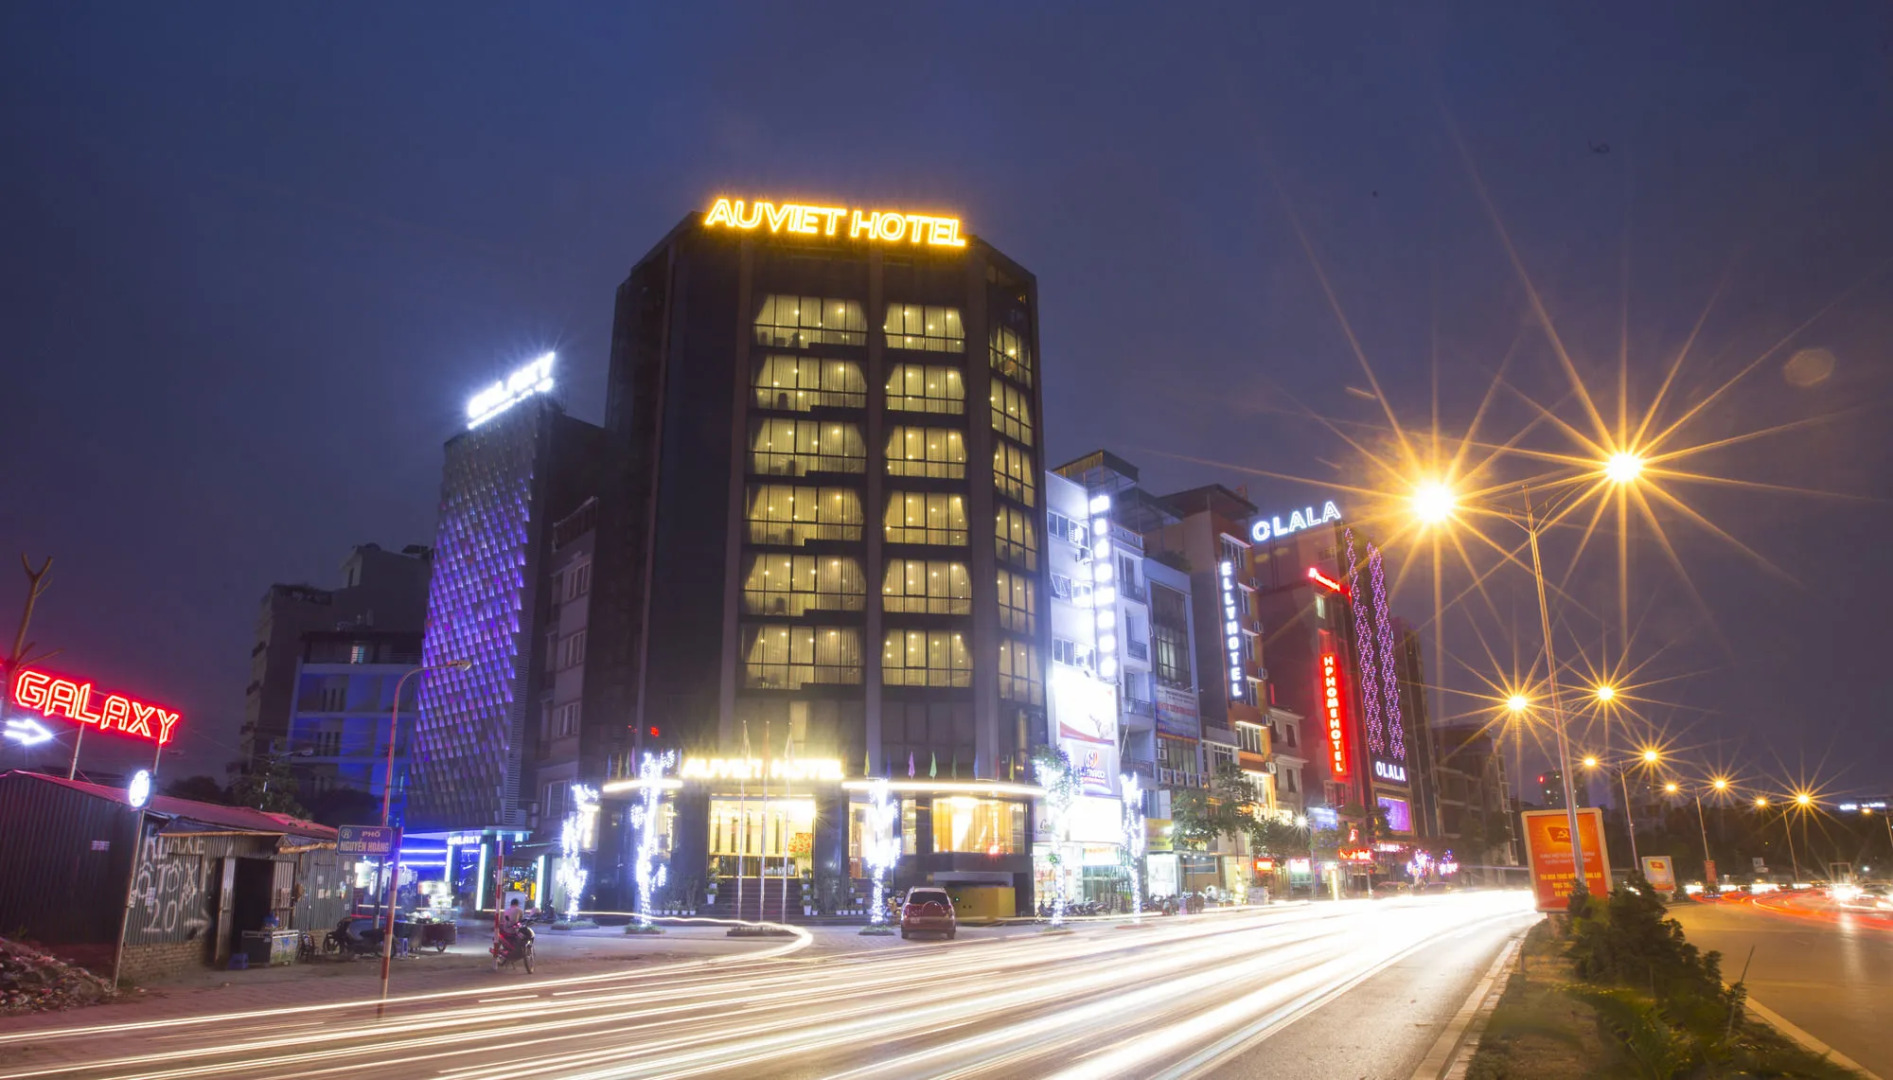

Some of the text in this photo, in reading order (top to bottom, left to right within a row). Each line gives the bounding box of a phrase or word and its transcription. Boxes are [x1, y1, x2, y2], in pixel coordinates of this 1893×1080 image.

[850, 209, 967, 247] HOTEL
[15, 670, 180, 745] GALAXY
[771, 758, 845, 780] HOTEL
[1375, 760, 1407, 782] OLALA
[447, 836, 482, 845] GALAXY
